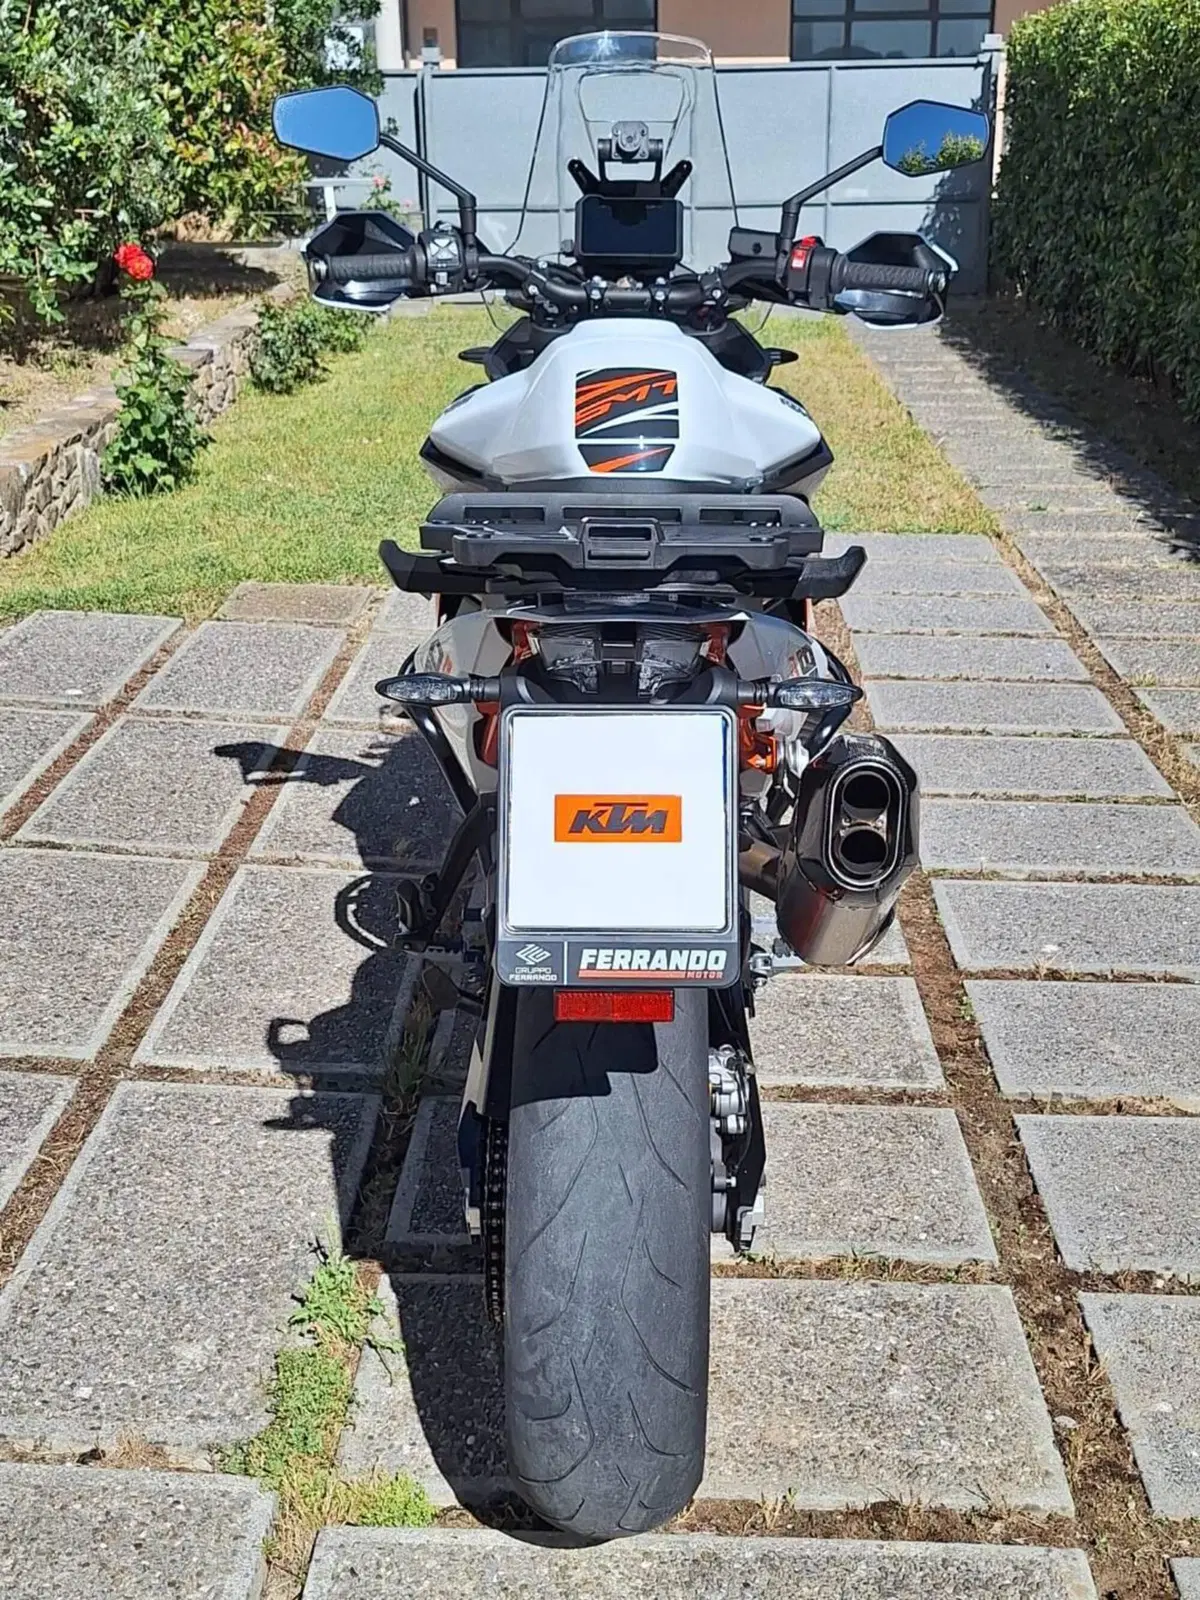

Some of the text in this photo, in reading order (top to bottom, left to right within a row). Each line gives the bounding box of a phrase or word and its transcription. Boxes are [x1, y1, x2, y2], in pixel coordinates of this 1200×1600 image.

[568, 802, 669, 834] KTM
[579, 948, 727, 971] FERRANDO
[514, 967, 552, 975] GRUPPO
[686, 970, 723, 979] MOTOR
[508, 974, 558, 982] FERRANDO
